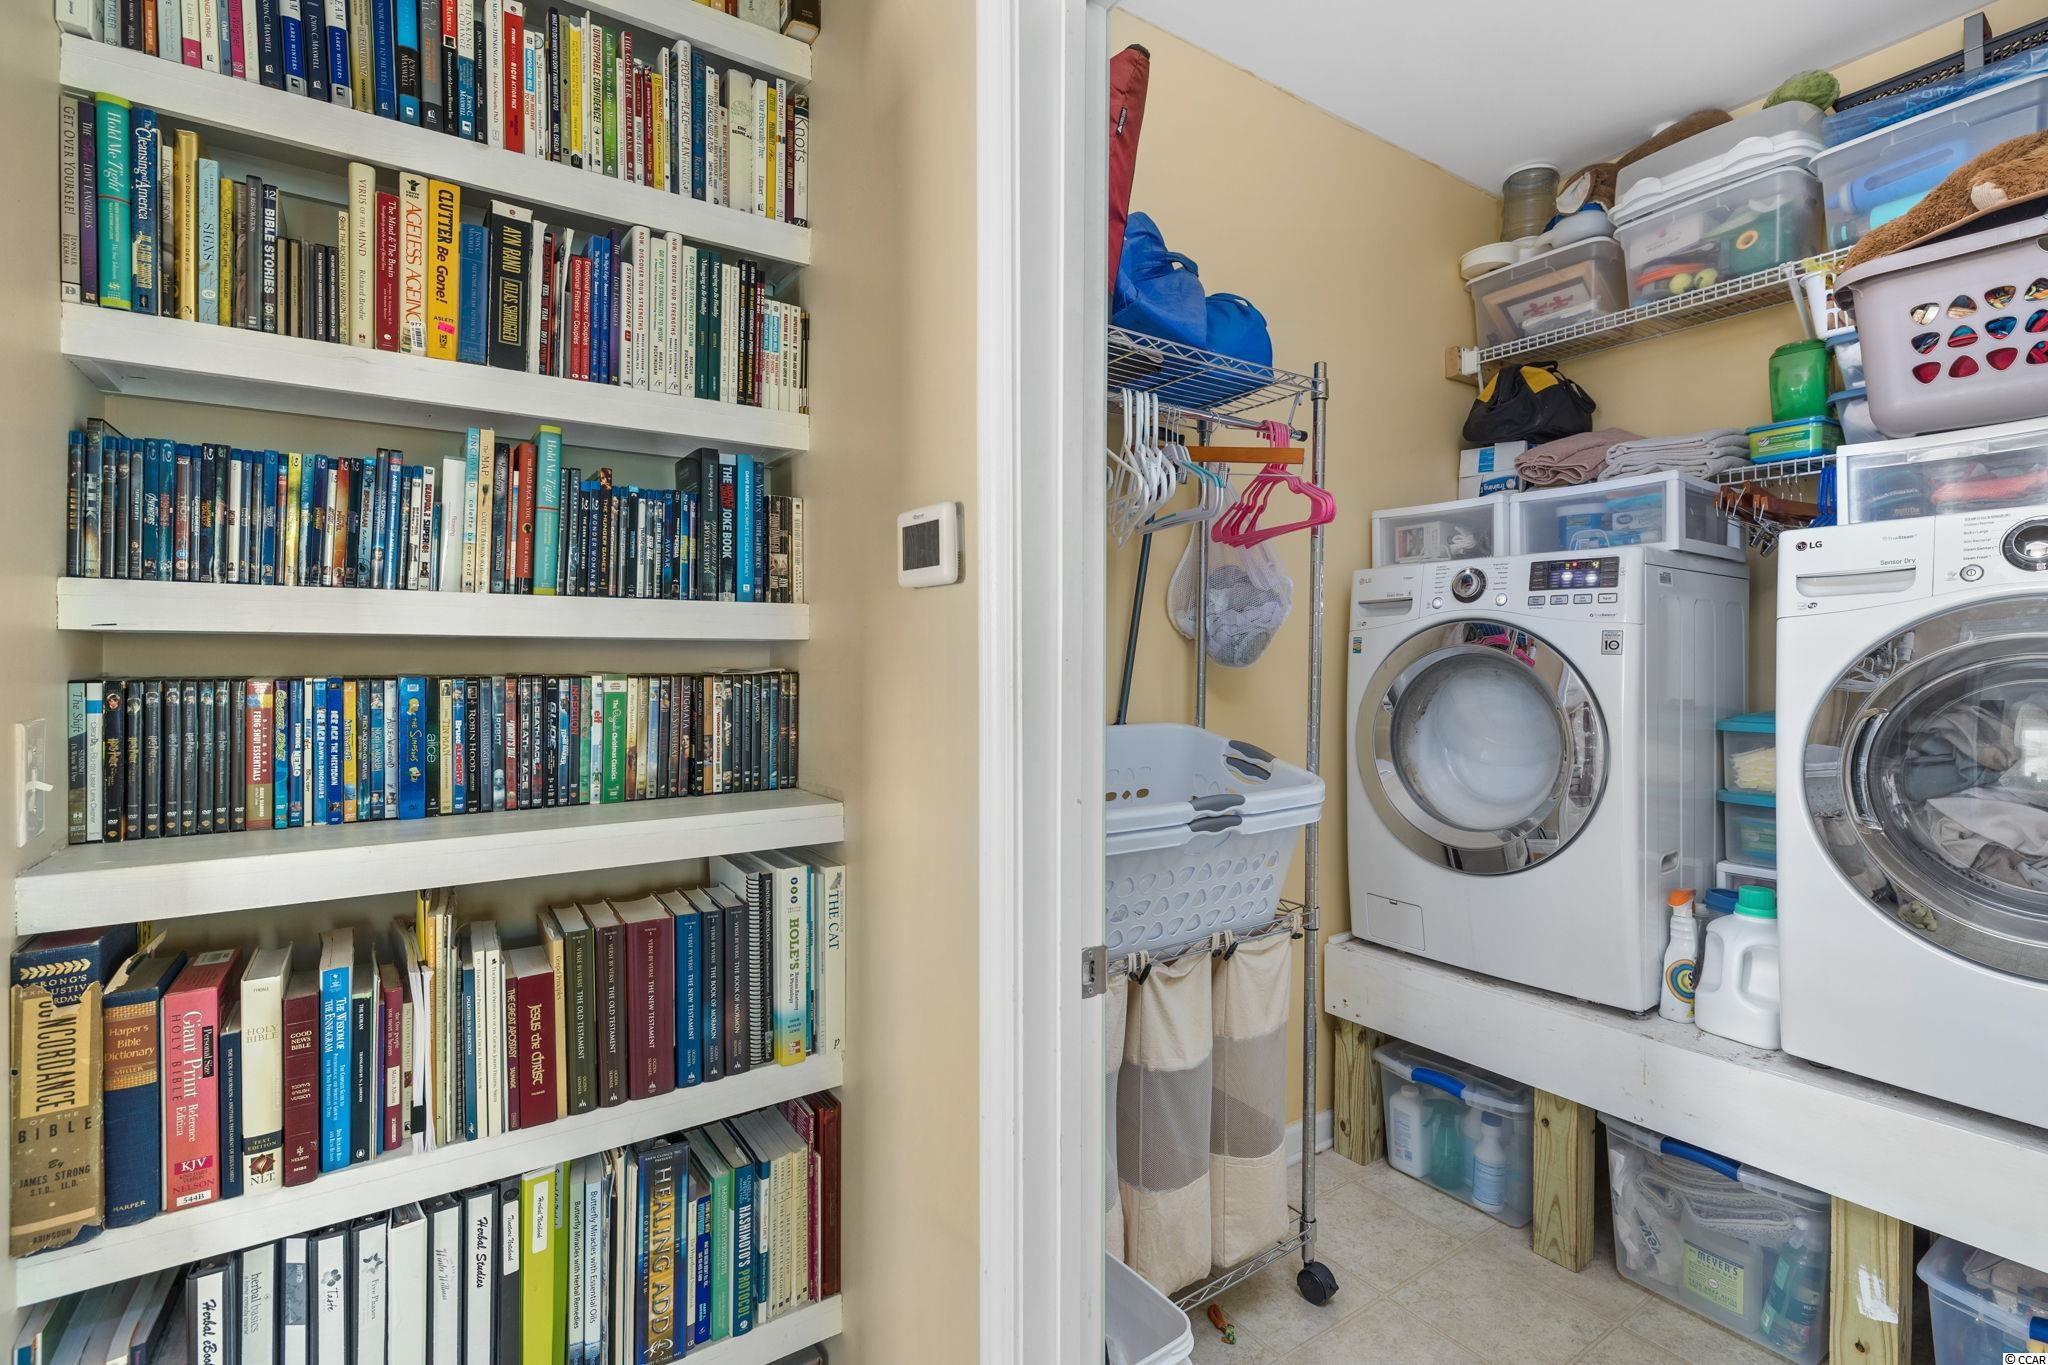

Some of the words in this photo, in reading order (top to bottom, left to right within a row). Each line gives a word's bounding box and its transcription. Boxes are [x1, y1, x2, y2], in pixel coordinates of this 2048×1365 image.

[593, 28, 601, 76] UNSTOPPABLE
[593, 77, 601, 123] CONFIDENCE!
[64, 106, 75, 127] GET
[83, 122, 93, 136] THE
[107, 112, 121, 140] Hold
[64, 130, 76, 157] OVER
[108, 142, 121, 158] Me
[134, 128, 152, 175] Cleansing
[794, 116, 808, 163] Knots
[83, 163, 93, 182] LOVE
[104, 160, 124, 192] Tight
[185, 174, 190, 184] NO
[64, 159, 76, 215] YOURSELF!
[135, 179, 150, 220] America
[264, 190, 276, 199] 12
[358, 179, 367, 204] VIRUS
[84, 184, 94, 229] LANGUAGES
[359, 207, 366, 215] OF
[388, 202, 396, 215] The
[437, 190, 454, 244] CLUTTER
[264, 208, 275, 242] BIBLE
[388, 216, 396, 235] Mind
[406, 201, 422, 265] AGELESS
[503, 225, 521, 247] AYN
[202, 223, 214, 261] SIGNS
[358, 230, 366, 256] MIND
[436, 246, 448, 261] Be
[264, 244, 275, 294] STORIES
[387, 258, 395, 278] Brain
[502, 248, 521, 274] RAND
[436, 267, 448, 304] Gone!
[574, 260, 582, 290] Emotional
[503, 281, 518, 303] ATLAS
[503, 304, 518, 342] SHRUGGED
[547, 440, 557, 462] Hold
[546, 464, 555, 476] Me
[722, 466, 732, 483] THE
[86, 473, 96, 520] HULK
[424, 484, 432, 512] DEADPOOL
[545, 479, 555, 503] Tight
[722, 508, 732, 530] JOKE
[722, 532, 732, 558] BOOK
[1809, 541, 1823, 549] LG
[1904, 557, 1916, 565] Dry
[73, 692, 83, 710] The
[72, 713, 83, 733] Shift
[253, 711, 261, 728] FENG
[253, 729, 261, 743] SHUI
[426, 734, 437, 763] alice
[253, 744, 261, 781] ESSENTIALS
[293, 751, 301, 777] NEMO
[829, 890, 839, 921] THE
[789, 918, 800, 970] HOLE'S
[829, 922, 839, 950] CAT
[325, 1000, 333, 1013] THE
[336, 997, 346, 1011] THE
[507, 988, 516, 1002] THE
[336, 1012, 346, 1040] WISDOM
[508, 1002, 516, 1024] GREAT
[528, 1004, 543, 1030] Jesus
[109, 1024, 148, 1037] Harper's
[117, 1037, 141, 1049] Bible
[171, 1015, 181, 1052] HOLY
[182, 1010, 202, 1055] Giant
[202, 1028, 213, 1059] Personal
[325, 1014, 335, 1053] ENNEAGRAM
[508, 1025, 517, 1059] APOSTASY
[530, 1033, 542, 1050] the
[106, 1046, 154, 1063] Dictionary
[336, 1041, 344, 1049] OF
[183, 1058, 202, 1099] Print
[203, 1060, 212, 1076] Size
[171, 1061, 182, 1103] BIBLE
[18, 1117, 92, 1144] BIBLE
[175, 1106, 188, 1137] Edition
[187, 1103, 199, 1143] Reference
[19, 1174, 48, 1189] JAMES
[55, 1164, 91, 1180] STRONG
[181, 1156, 206, 1172] KJV
[173, 1178, 215, 1194] NELSON
[113, 1200, 147, 1212] HARPER
[573, 1201, 581, 1230] Butterfly
[589, 1191, 598, 1224] Butterfly
[476, 1217, 488, 1250] Herbal
[652, 1165, 674, 1277] HEALING
[573, 1231, 581, 1258] Miracles
[590, 1225, 598, 1257] Miracles
[738, 1206, 751, 1268] HASHIMOTO'S
[476, 1254, 487, 1289] Studies
[251, 1272, 262, 1302] herbal
[326, 1287, 339, 1312] Taste
[371, 1278, 379, 1295] Five
[589, 1275, 597, 1307] Essential
[737, 1270, 751, 1319] PROTOCOL
[203, 1299, 218, 1337] Herbal
[251, 1303, 260, 1333] basics
[652, 1282, 673, 1335] ADD
